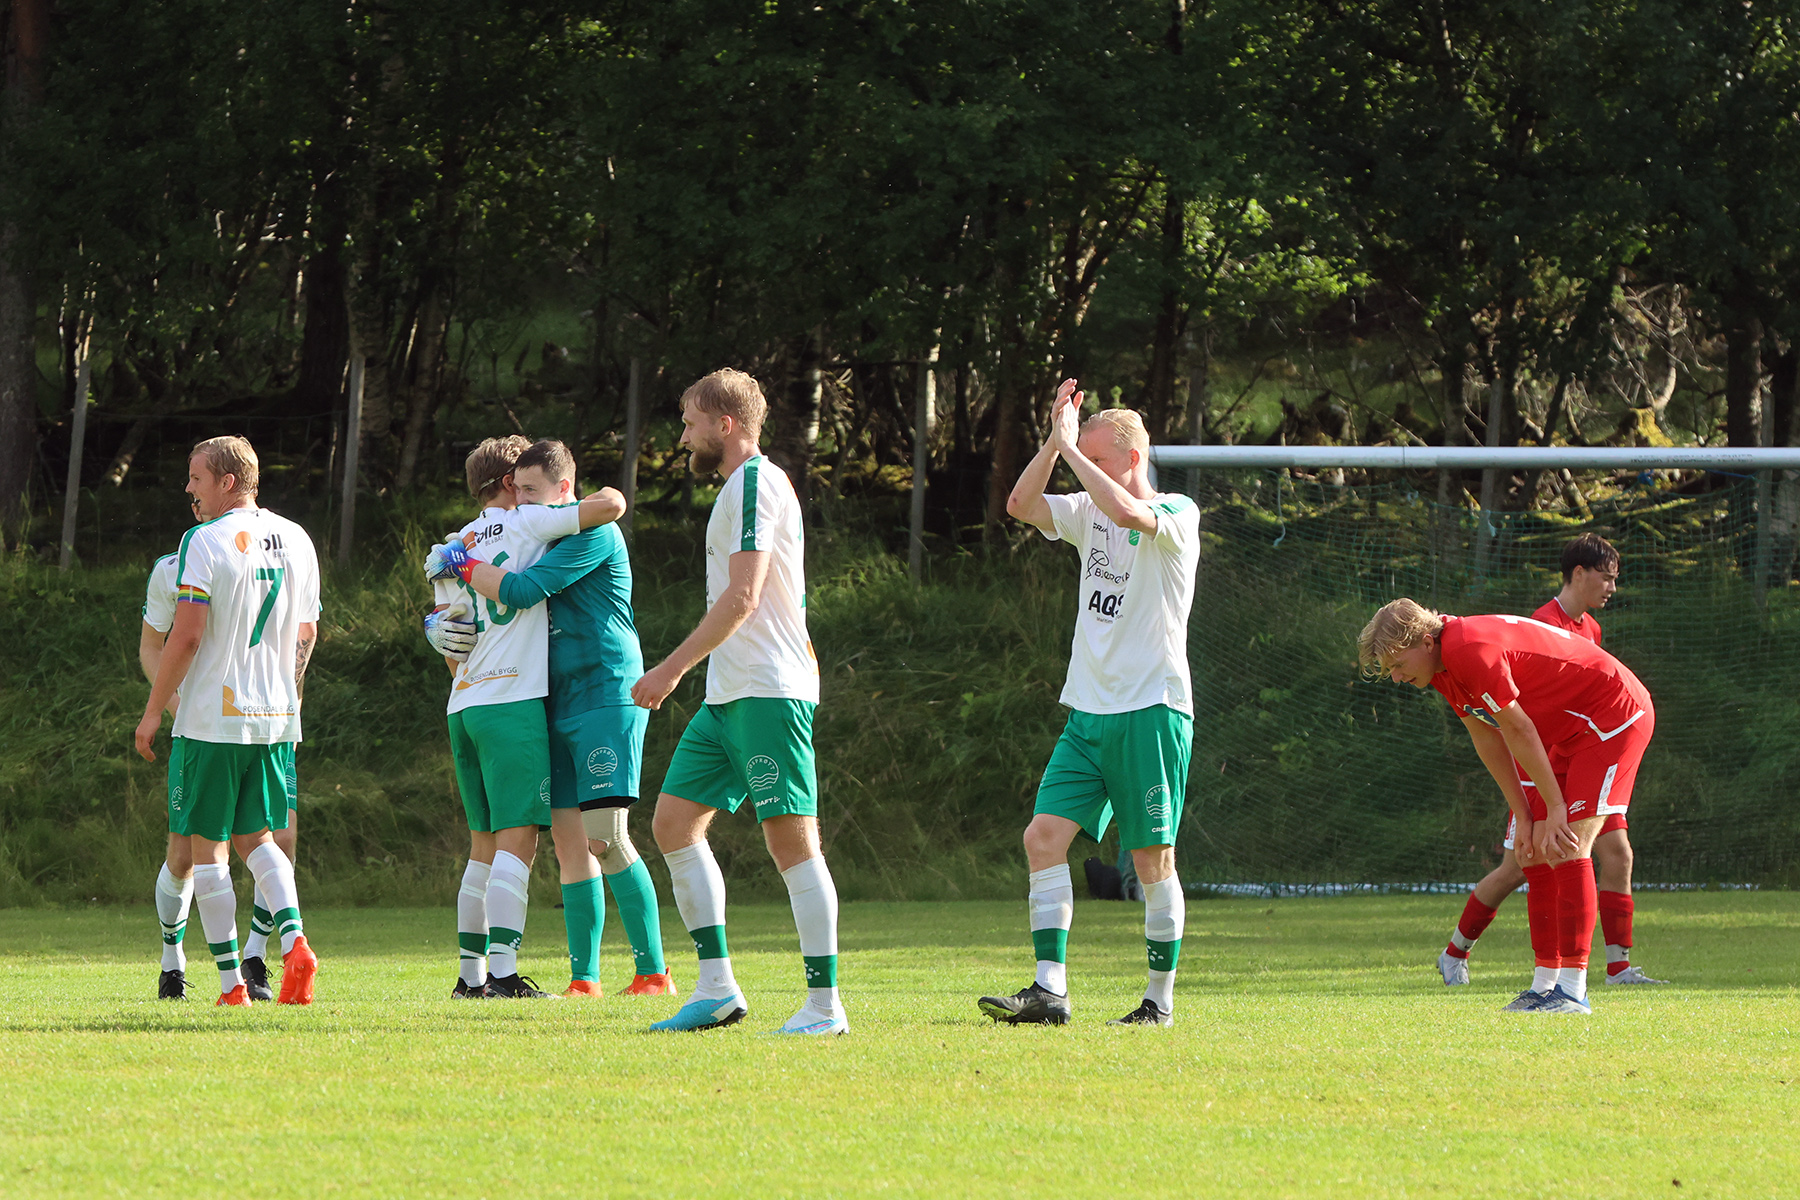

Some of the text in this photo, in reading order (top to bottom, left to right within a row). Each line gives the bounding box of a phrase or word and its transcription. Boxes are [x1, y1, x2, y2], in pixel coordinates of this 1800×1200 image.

[248, 567, 285, 649] 7
[498, 666, 518, 675] BYGG
[242, 705, 278, 713] ROSENDAL
